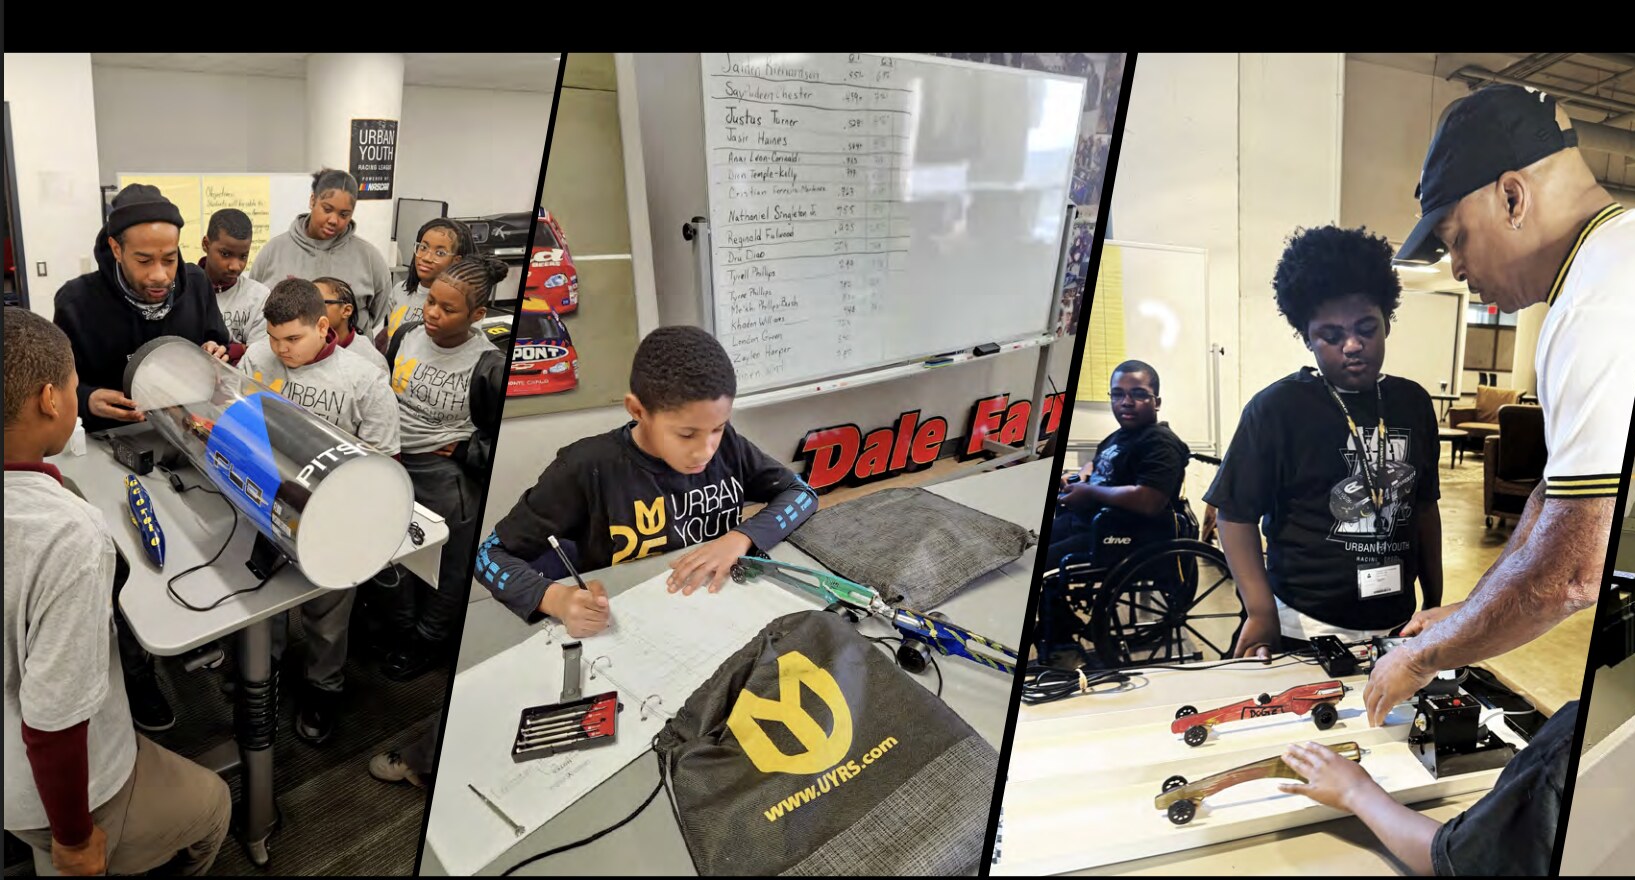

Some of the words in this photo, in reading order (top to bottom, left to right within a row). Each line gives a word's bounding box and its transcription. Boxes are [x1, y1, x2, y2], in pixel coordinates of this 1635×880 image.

[725, 106, 762, 126] Justus
[770, 109, 799, 126] Turner
[359, 129, 395, 145] URBAN
[358, 145, 394, 161] YOUTH
[367, 182, 390, 191] NASCAR
[223, 310, 251, 327] BAN
[413, 363, 469, 393] URBAN
[409, 381, 466, 411] YOUTH
[802, 411, 948, 490] Dale
[296, 443, 369, 488] PITS
[671, 476, 744, 520] URBAN
[674, 507, 743, 548] YOUTH
[1103, 536, 1132, 545] drive
[1345, 541, 1376, 552] URBAN
[763, 735, 899, 822] www.UYRS.com
